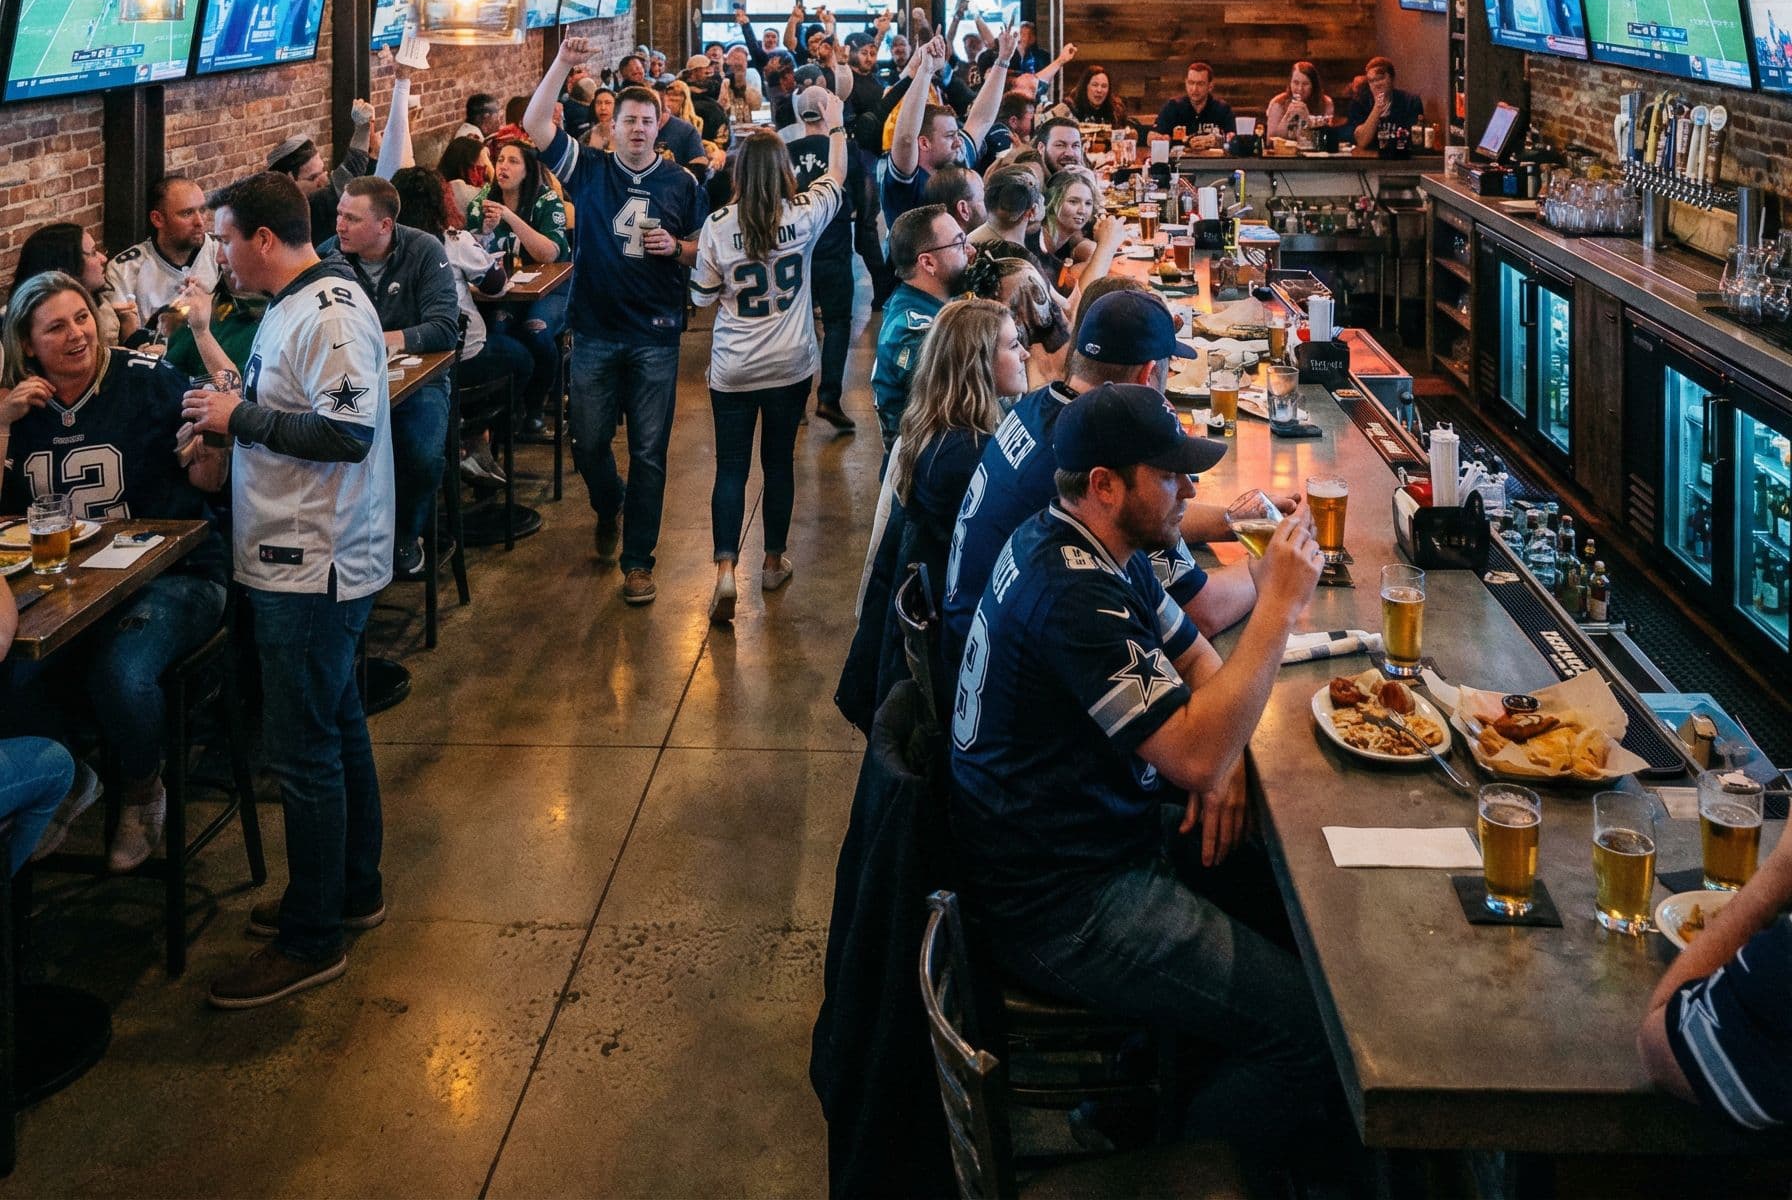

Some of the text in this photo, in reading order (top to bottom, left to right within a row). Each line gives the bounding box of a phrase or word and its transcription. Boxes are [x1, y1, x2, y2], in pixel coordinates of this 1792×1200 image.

[612, 196, 650, 259] 4
[732, 253, 803, 318] 29
[24, 443, 131, 519] 12
